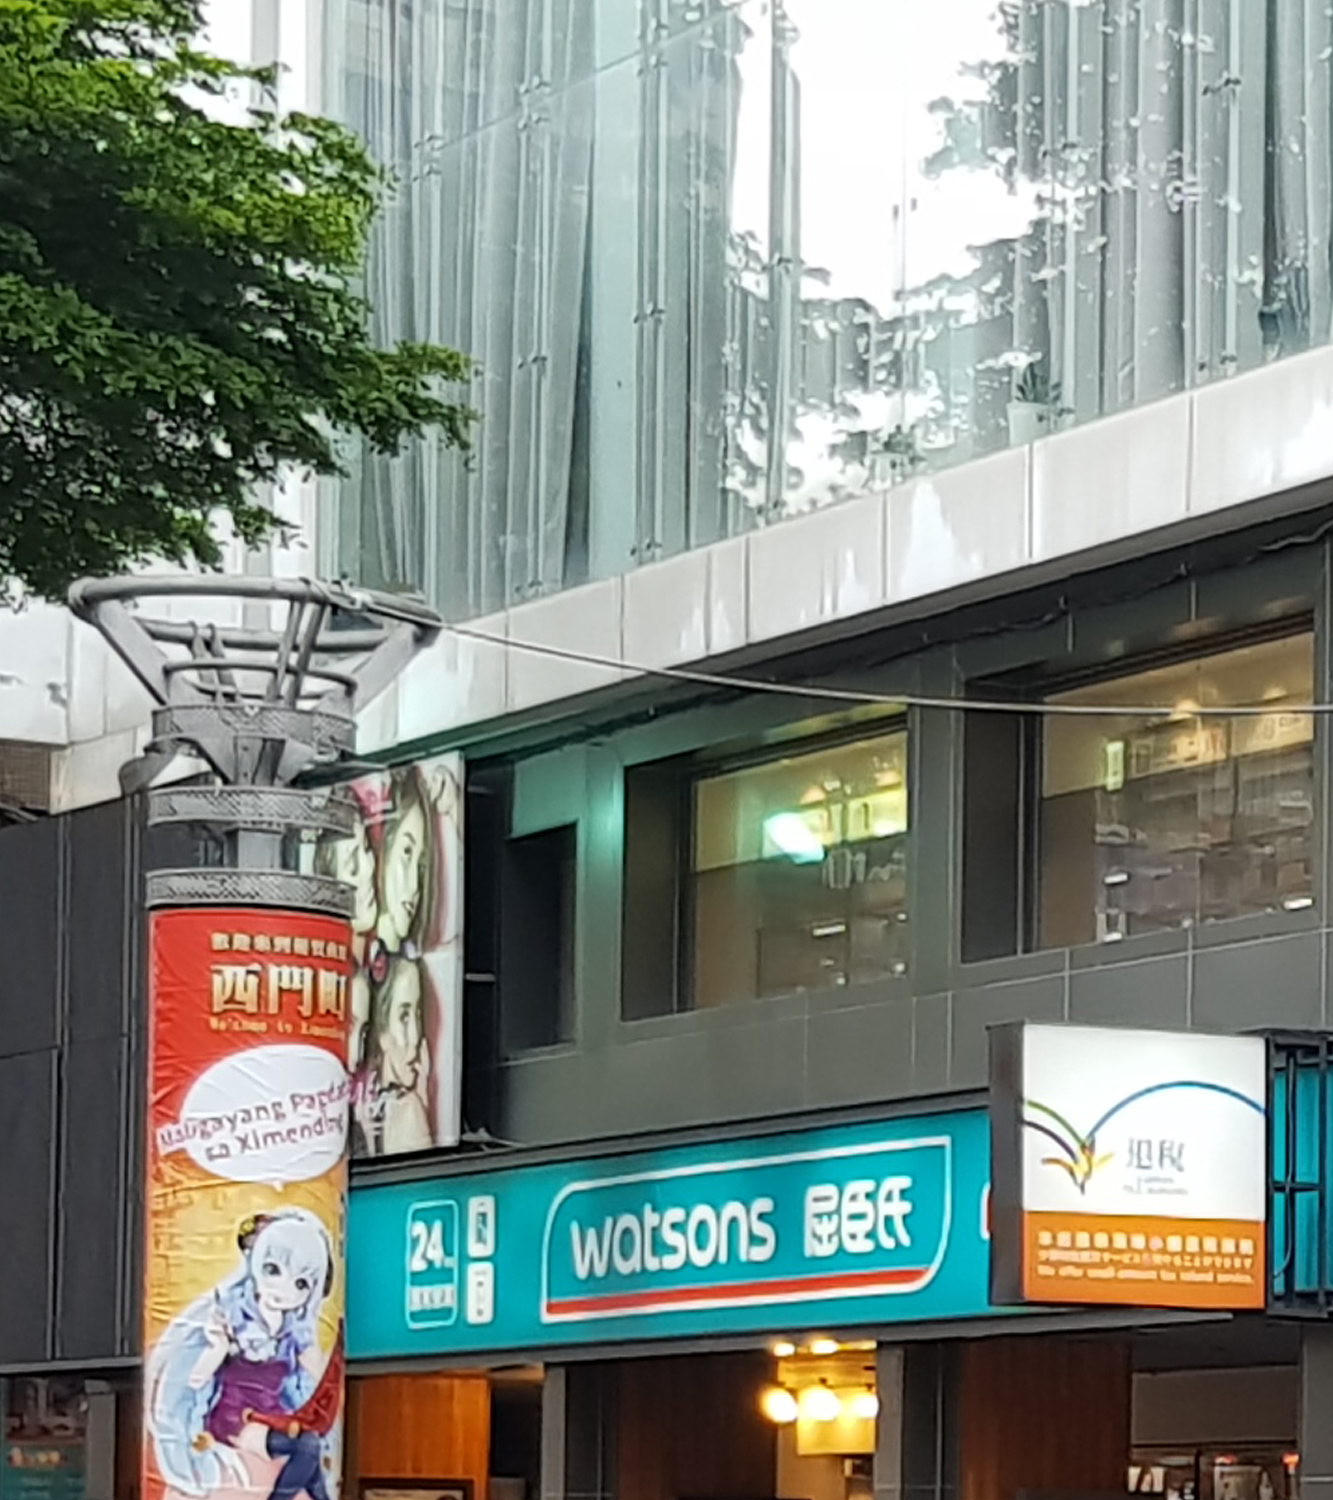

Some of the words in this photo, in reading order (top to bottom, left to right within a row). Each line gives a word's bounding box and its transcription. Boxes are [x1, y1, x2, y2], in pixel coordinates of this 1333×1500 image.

[210, 963, 347, 1021] 西門町
[410, 1219, 444, 1271] 24
[569, 1198, 775, 1280] watsons
[804, 1176, 913, 1258] 屈臣氏
